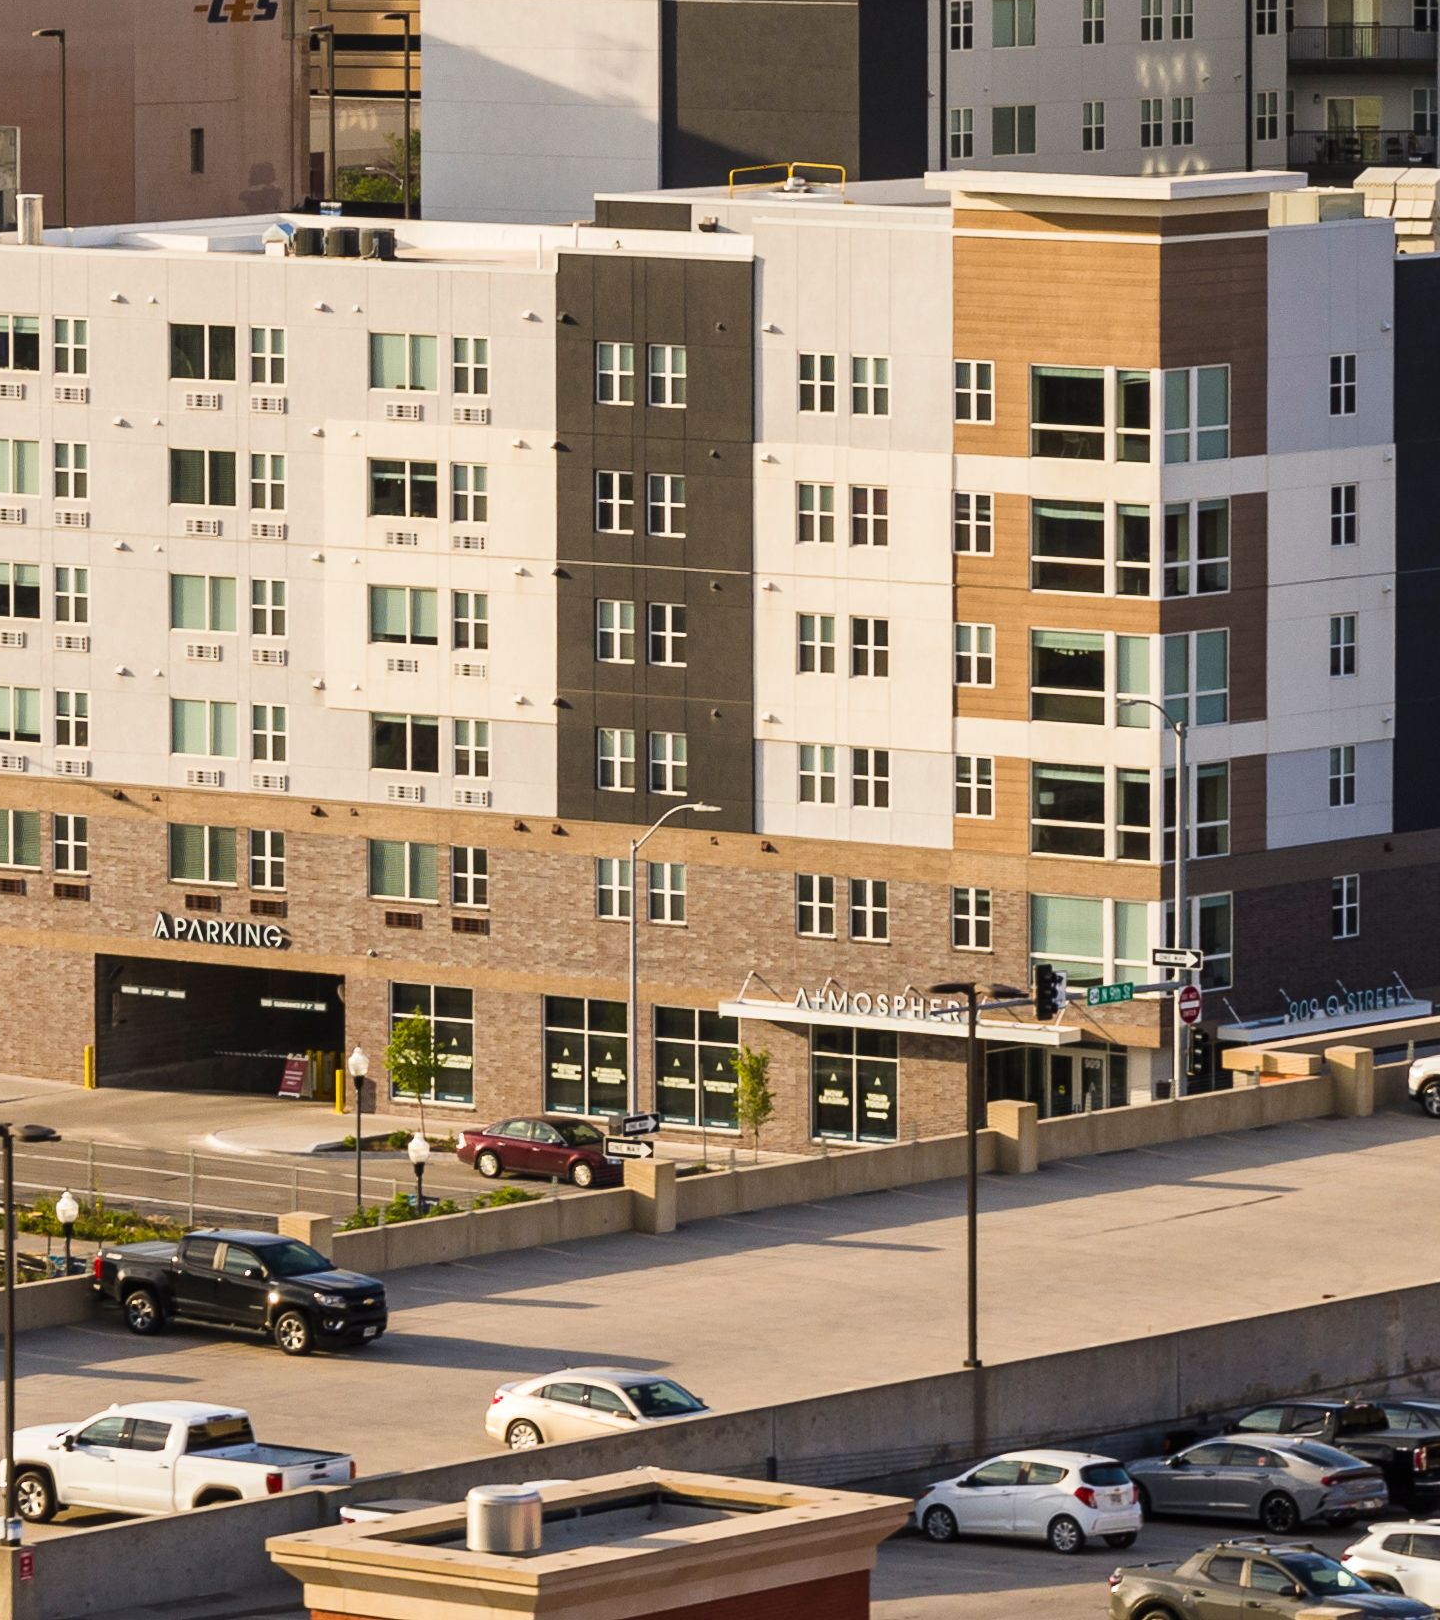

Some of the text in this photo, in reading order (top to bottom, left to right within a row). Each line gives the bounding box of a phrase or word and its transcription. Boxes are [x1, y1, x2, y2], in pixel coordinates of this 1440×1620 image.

[173, 917, 284, 948] PARKING
[1289, 984, 1403, 1021] 909 Q STREET
